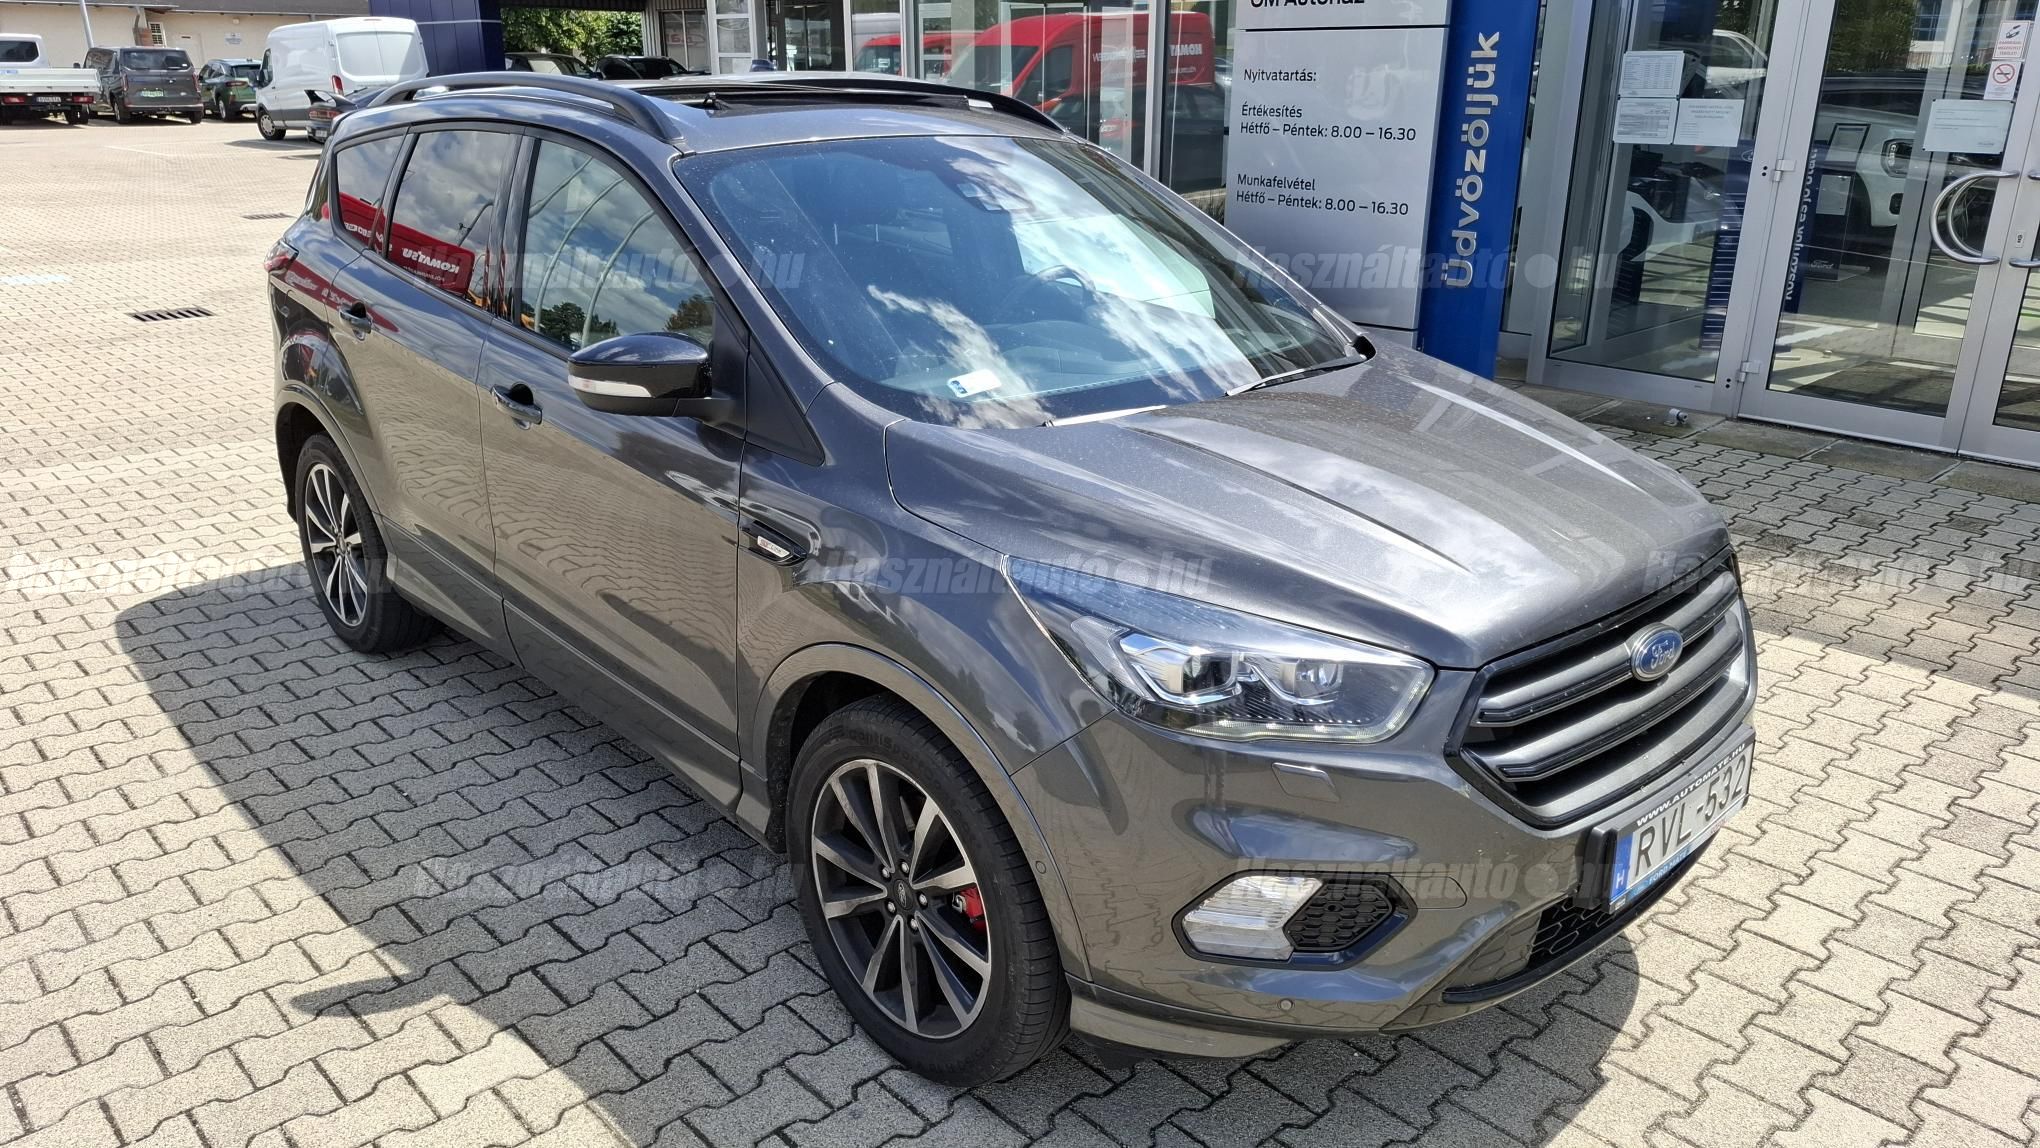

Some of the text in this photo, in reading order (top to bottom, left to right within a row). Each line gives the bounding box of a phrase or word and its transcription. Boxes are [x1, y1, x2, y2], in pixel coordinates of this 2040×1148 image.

[1243, 69, 1317, 83] Nyitvatartás:
[1241, 101, 1303, 118] Értékesítés
[1240, 122, 1270, 135] Hétfő
[1282, 124, 1328, 137] Péntek:
[1330, 125, 1362, 139] 8.00
[1378, 127, 1417, 141] 16.30
[1441, 31, 1500, 288] Üdvözöljük
[1237, 173, 1316, 191] Munkafelvétel
[1236, 190, 1265, 204] Hétfő
[1277, 194, 1322, 209] Péntek:
[1324, 198, 1356, 212] 8.00
[1371, 201, 1409, 216] 16.30
[1651, 639, 1676, 670] Ford
[1636, 743, 1746, 827] WWW.AUTOMATE.HU
[1616, 868, 1625, 889] H
